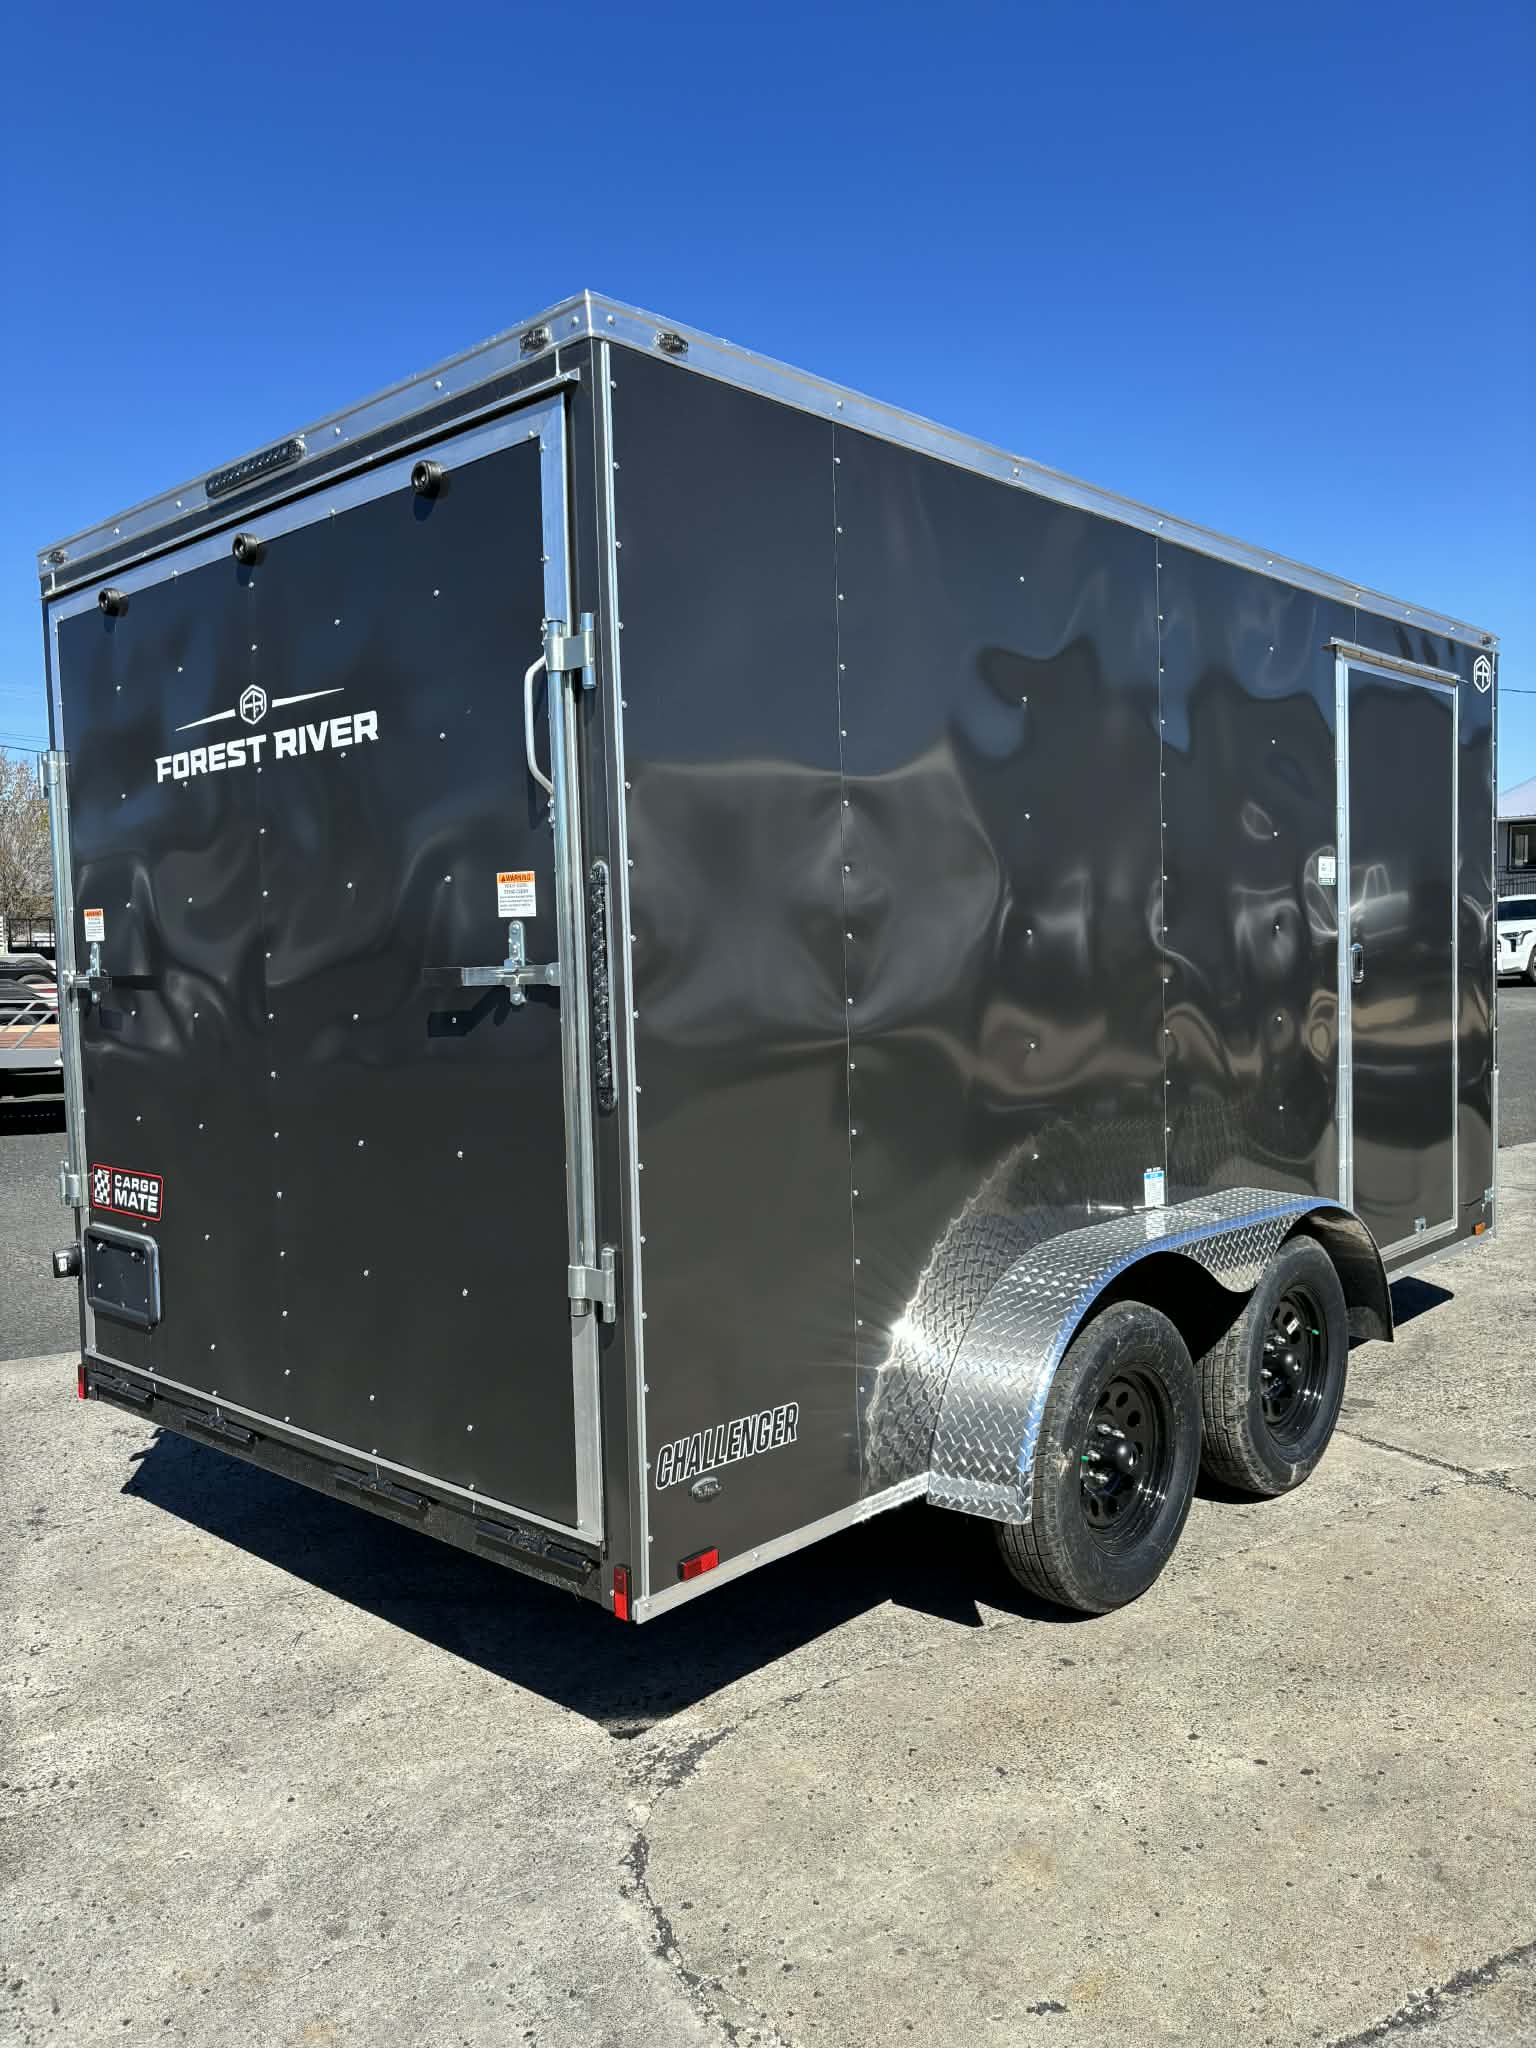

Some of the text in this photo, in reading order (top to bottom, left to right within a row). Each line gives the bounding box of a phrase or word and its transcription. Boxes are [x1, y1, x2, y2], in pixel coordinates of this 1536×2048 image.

[155, 710, 379, 783] FOREST RIVER
[114, 1174, 159, 1194] CARGO
[114, 1188, 159, 1213] MATE
[655, 1401, 799, 1490] CHALLENGER
